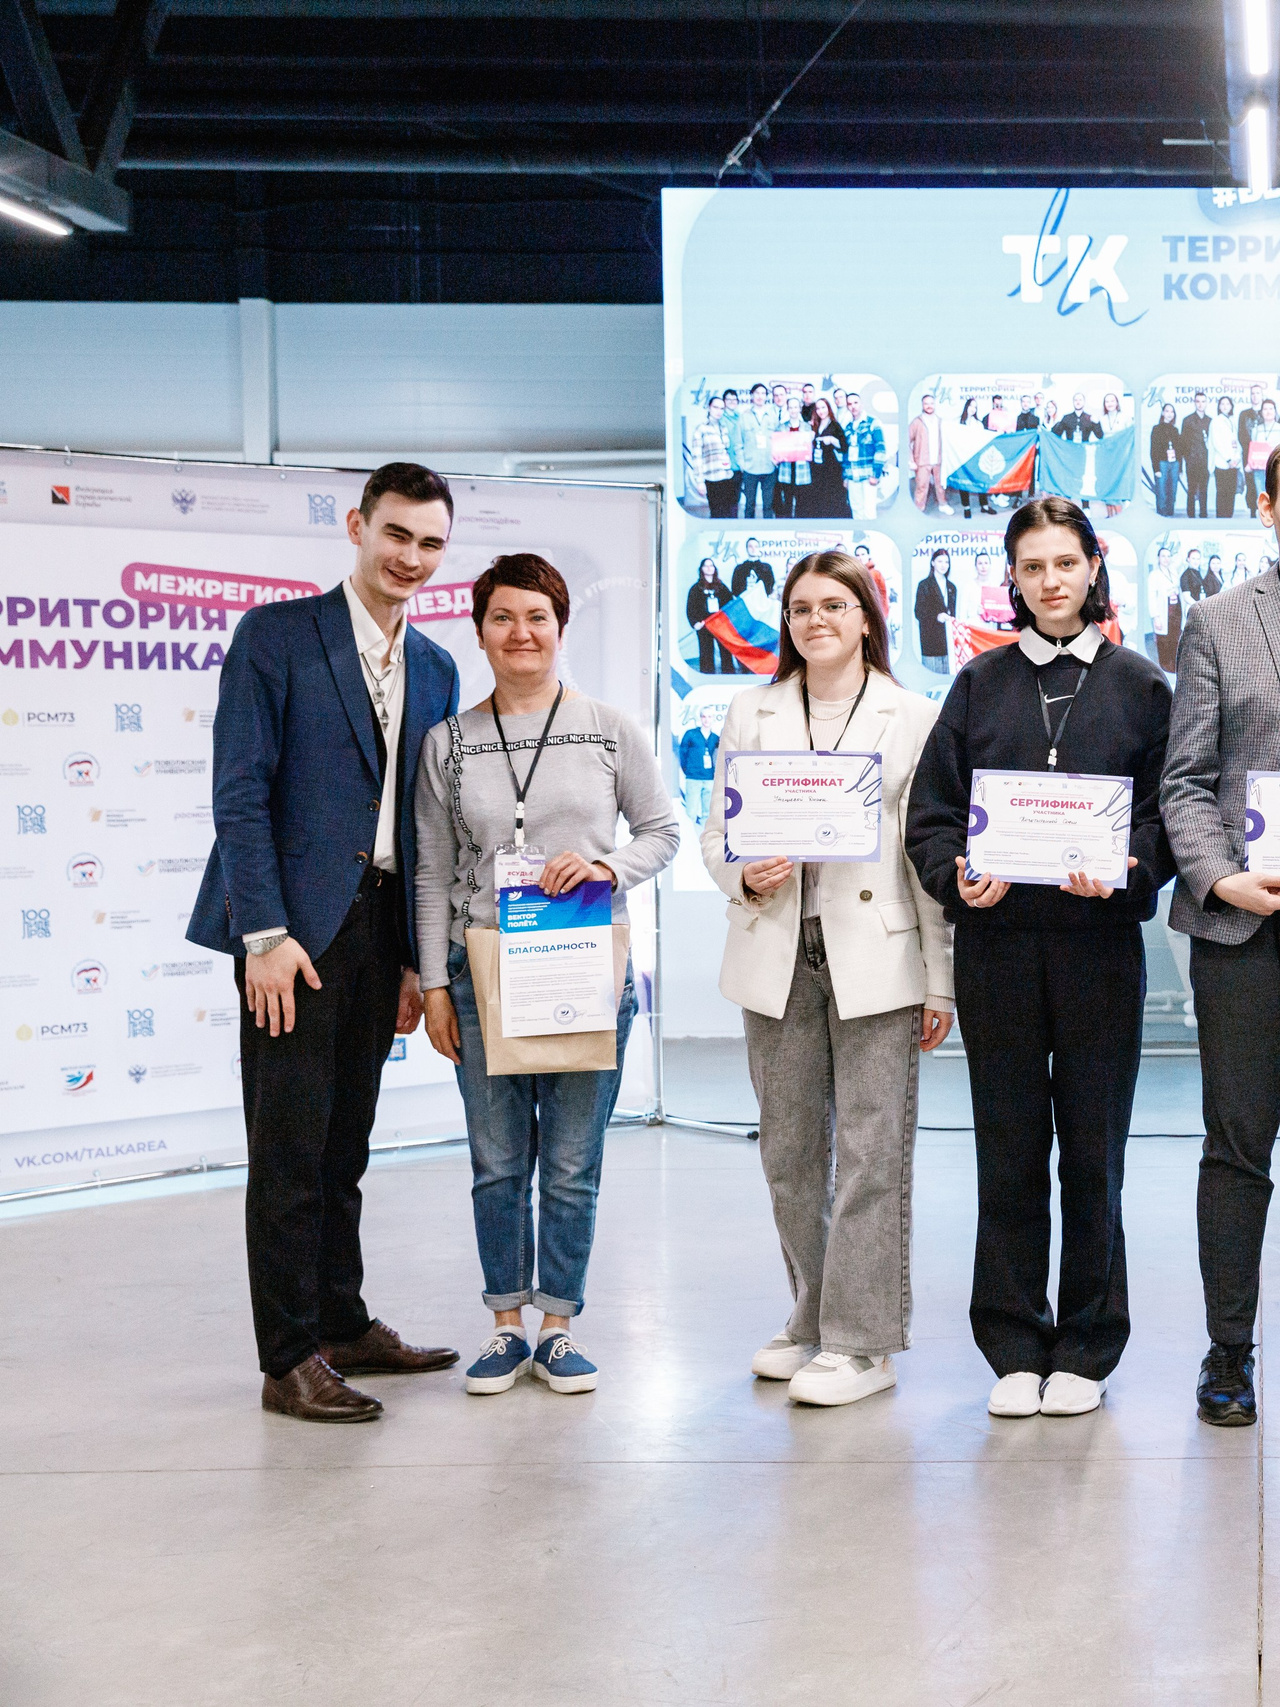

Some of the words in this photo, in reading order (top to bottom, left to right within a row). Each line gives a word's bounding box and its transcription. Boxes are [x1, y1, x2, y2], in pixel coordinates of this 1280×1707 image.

[0, 597, 227, 631] РИТОРИЯ
[27, 712, 75, 723] РСМ73
[762, 778, 845, 787] СЕРТИФИКАТ
[1010, 798, 1094, 810] СЕРТИФИКАТ
[507, 913, 537, 921] ВЕКТОР
[508, 941, 597, 955] БЛАГОДАРНОСТЬ
[41, 1023, 88, 1036] РСМ73
[14, 1140, 167, 1169] VK.COM/TALKAREA
